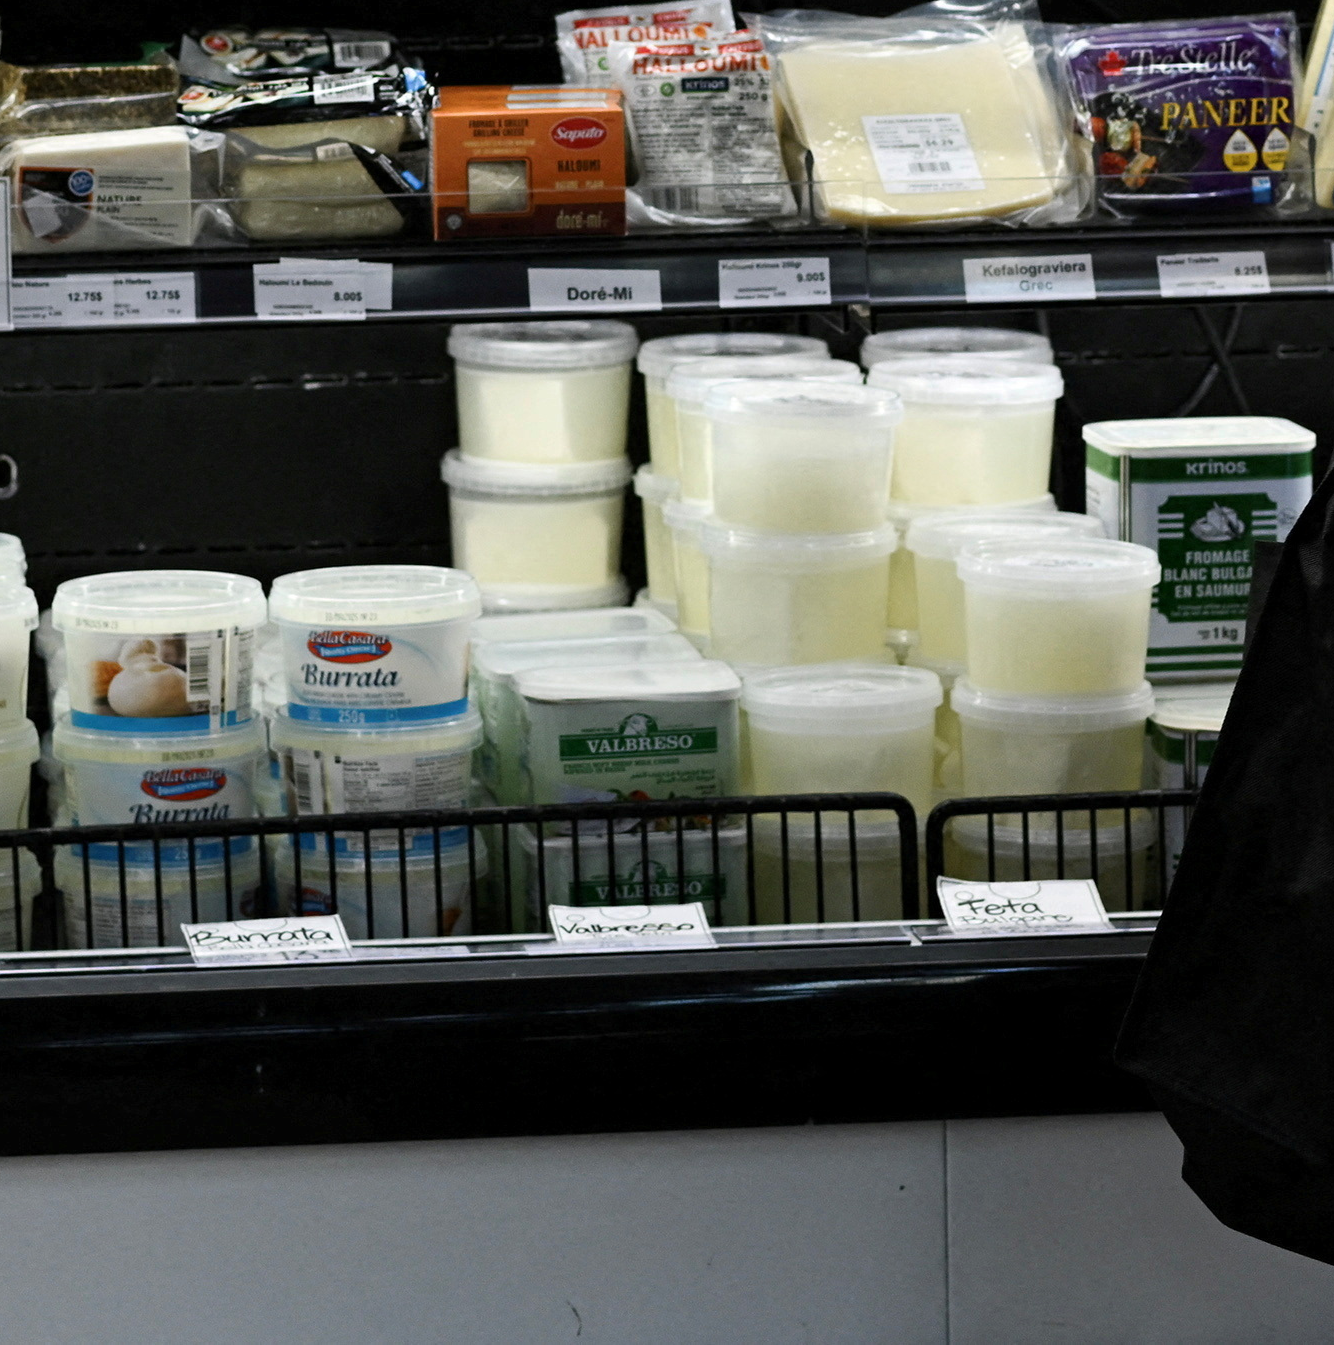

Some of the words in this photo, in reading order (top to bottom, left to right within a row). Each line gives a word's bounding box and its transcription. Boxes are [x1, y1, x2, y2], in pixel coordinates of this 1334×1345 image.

[631, 54, 758, 75] HALLOUMI
[738, 91, 759, 101] 250
[1159, 96, 1292, 132] PANEER
[553, 124, 606, 144] Saputo
[557, 159, 602, 173] HALOUMI
[981, 260, 1087, 278] Kefalograviera
[1160, 258, 1186, 266] Paneer
[796, 271, 826, 283] 9.00$
[567, 285, 633, 302] Doré-Mi
[1018, 279, 1054, 293] Grec
[67, 291, 103, 302] 12.75$
[145, 289, 181, 301] 12.75$
[333, 291, 363, 302] 8.00$
[1185, 549, 1251, 565] FROMAGE
[1163, 567, 1208, 582] BLANC
[1174, 584, 1192, 598] EN
[308, 630, 339, 644] Bella
[338, 630, 390, 644] Casara
[1221, 626, 1238, 641] kg
[301, 663, 401, 688] Burrata
[586, 734, 693, 754] VALBRESO
[129, 802, 230, 824] Burrata
[957, 897, 1044, 917] Feta
[189, 927, 333, 946] Burrata
